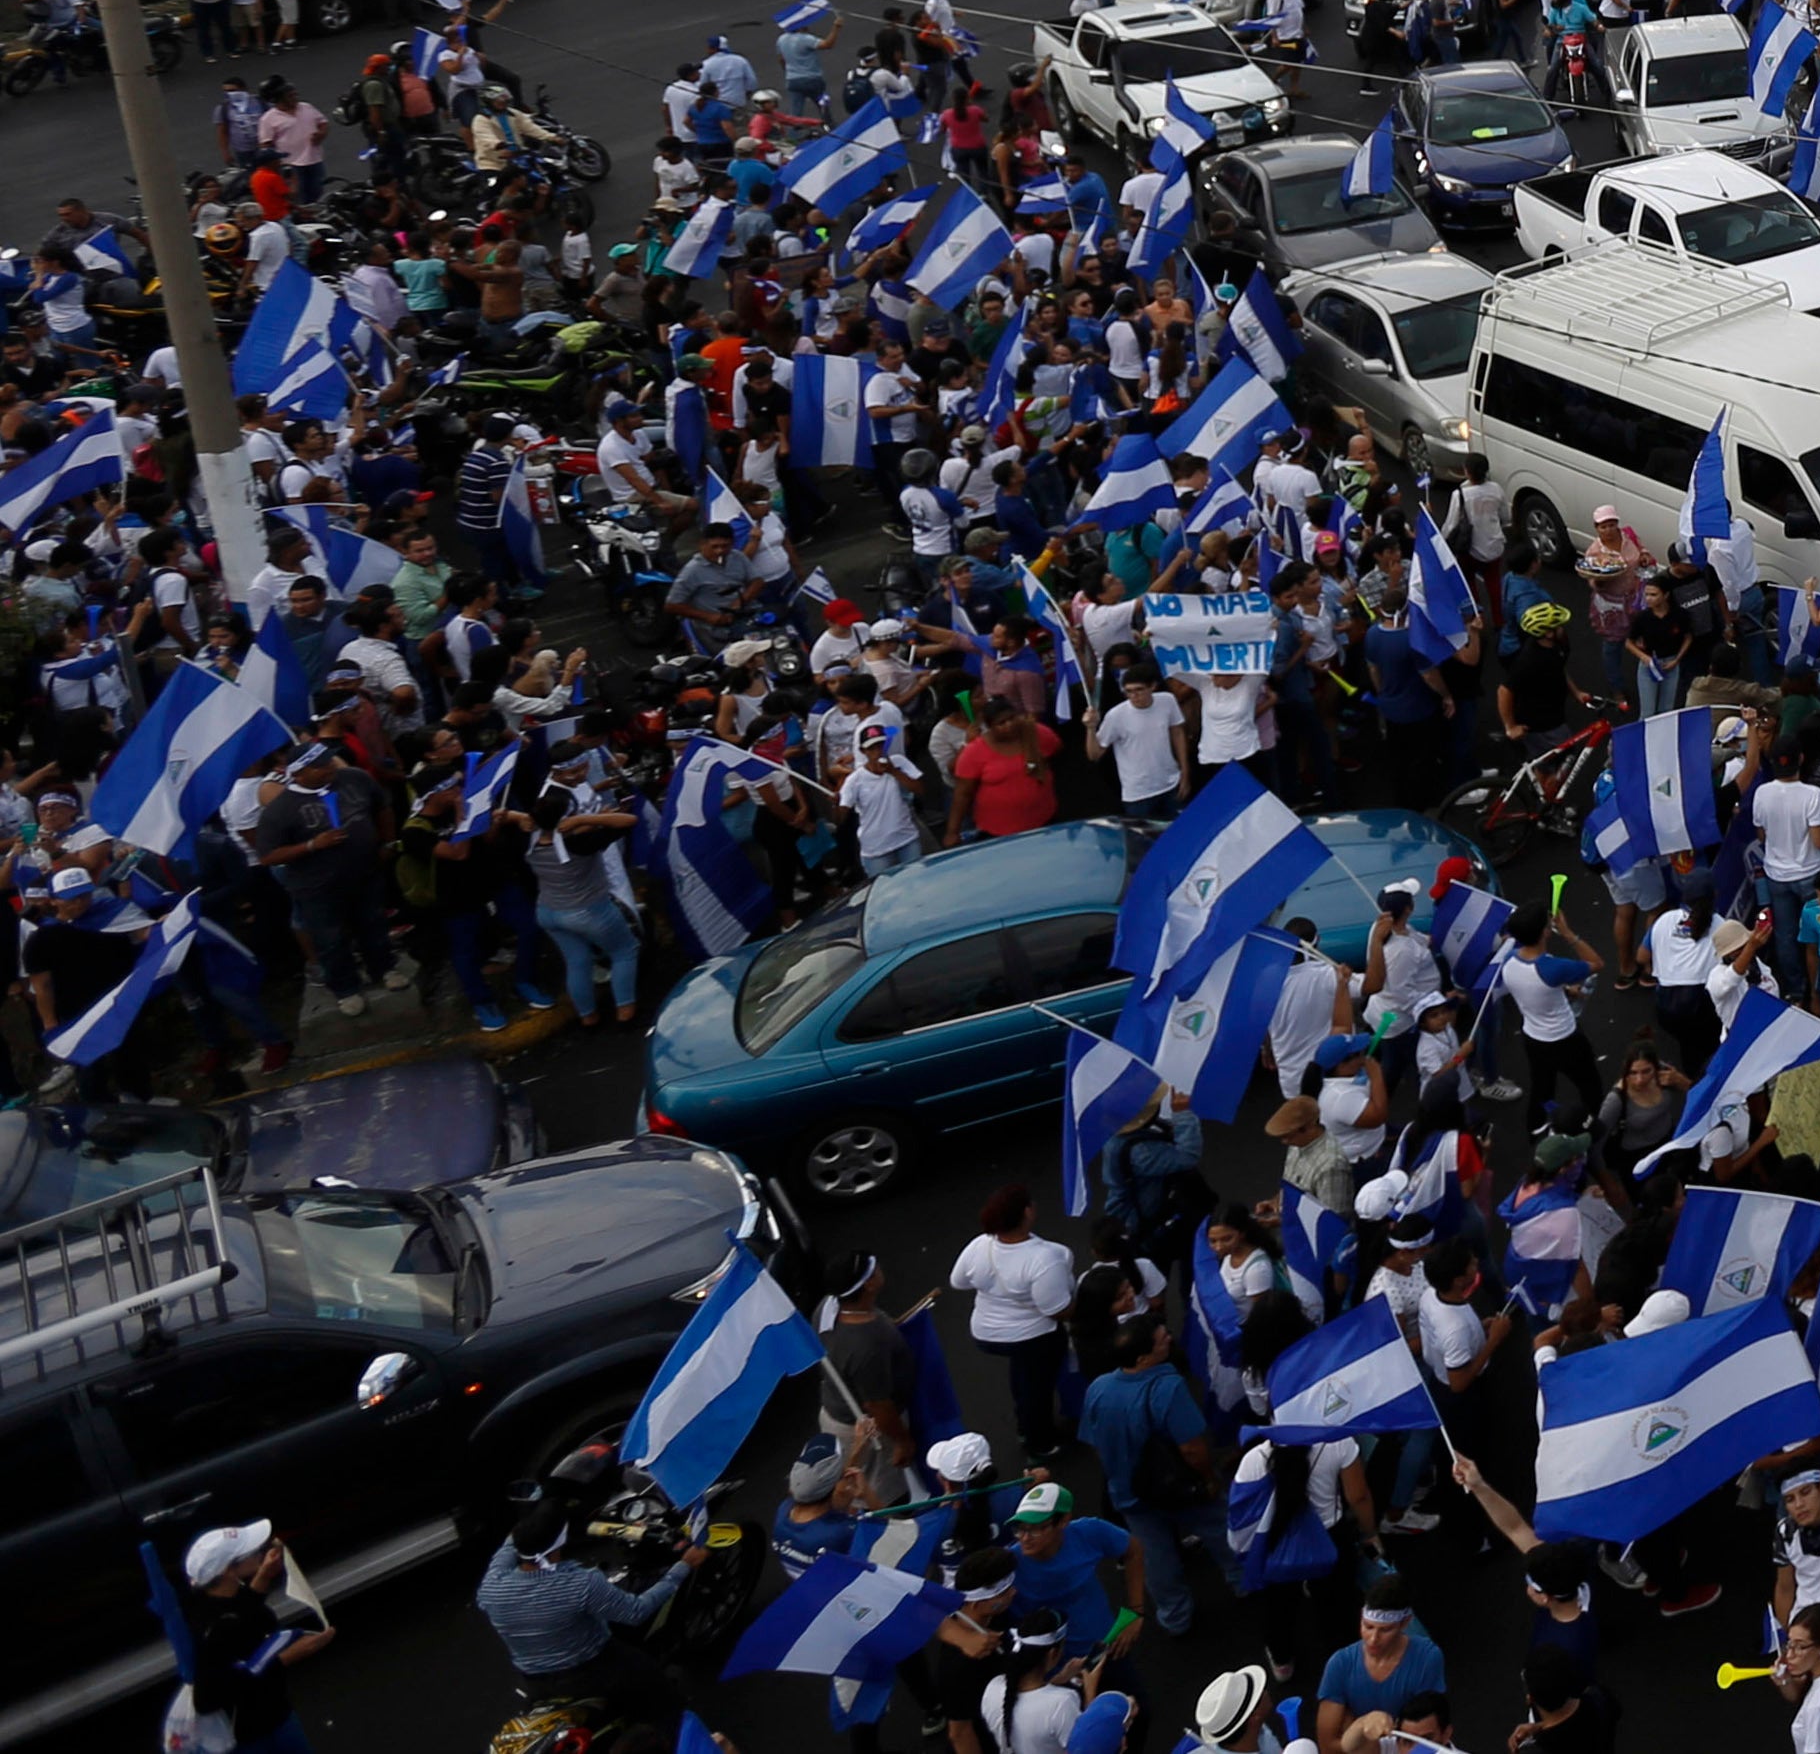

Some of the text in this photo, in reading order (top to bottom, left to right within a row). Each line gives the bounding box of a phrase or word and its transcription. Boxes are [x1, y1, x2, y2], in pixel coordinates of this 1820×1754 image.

[1145, 591, 1271, 617] NO MAS
[128, 1298, 160, 1314] THULE
